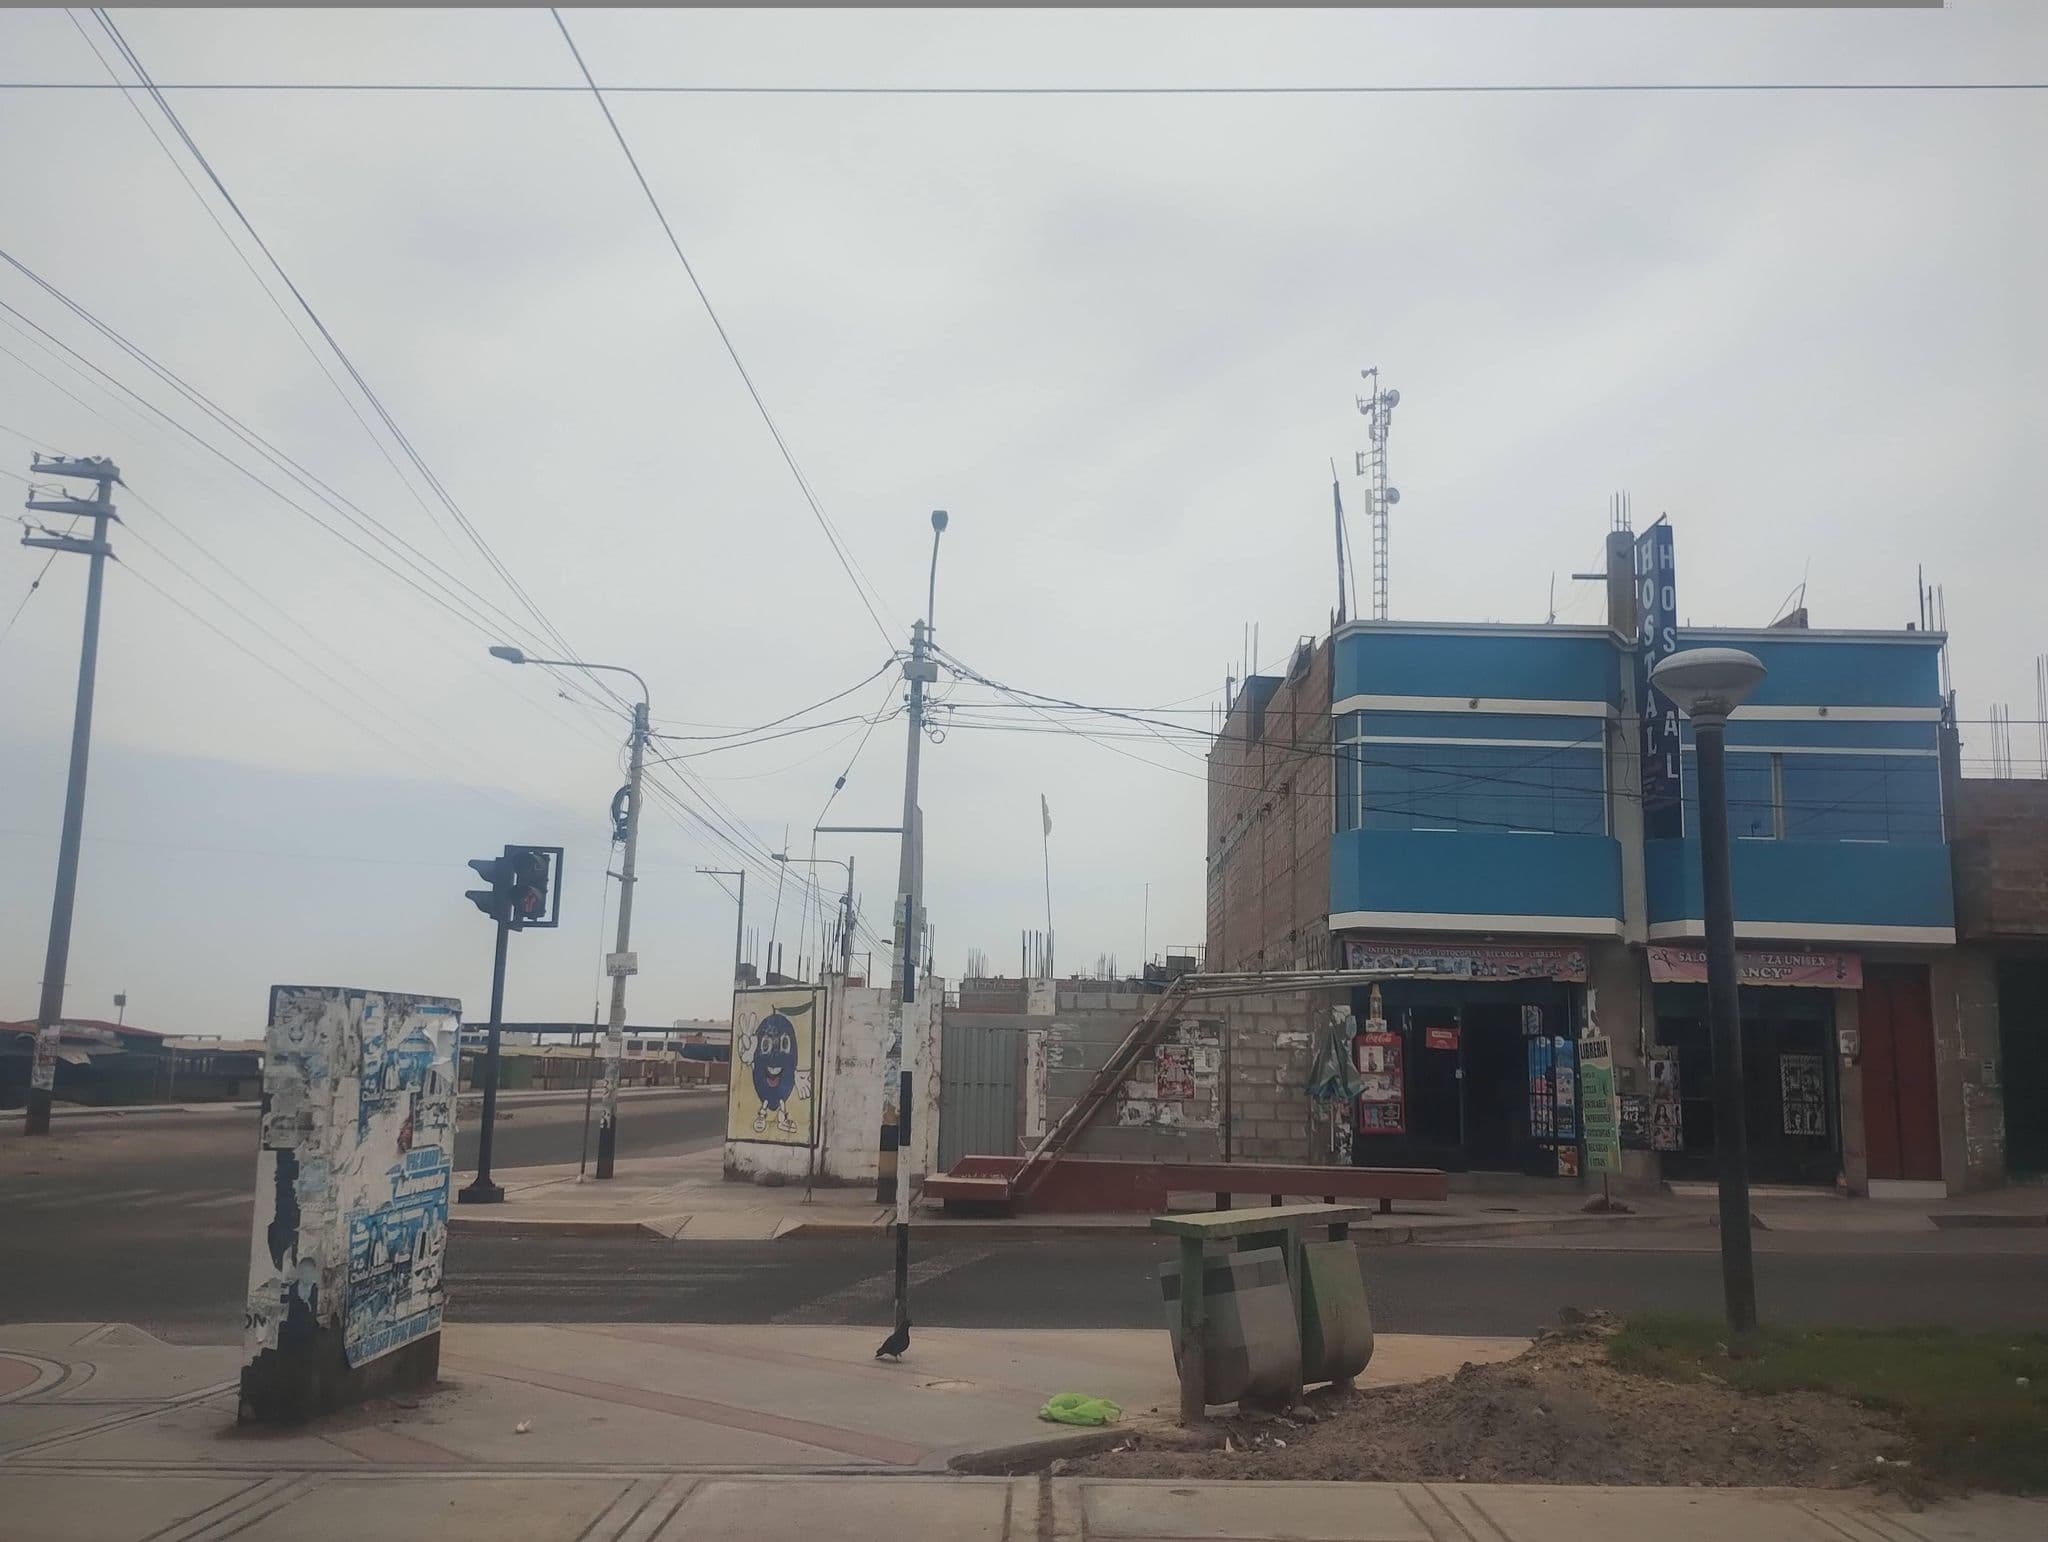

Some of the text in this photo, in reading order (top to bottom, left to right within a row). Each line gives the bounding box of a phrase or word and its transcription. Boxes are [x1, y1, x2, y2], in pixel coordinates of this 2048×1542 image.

[1640, 539, 1657, 757] HOSTAL
[1660, 545, 1678, 779] HOSAL
[1368, 946, 1404, 955] INTERNET
[1409, 948, 1432, 956] PAGOS
[1436, 949, 1481, 957] FOTOCOPIAS
[1679, 952, 1707, 962] SALO
[1736, 967, 1792, 978] ANCY"
[1579, 1040, 1609, 1059] LIBRERIA
